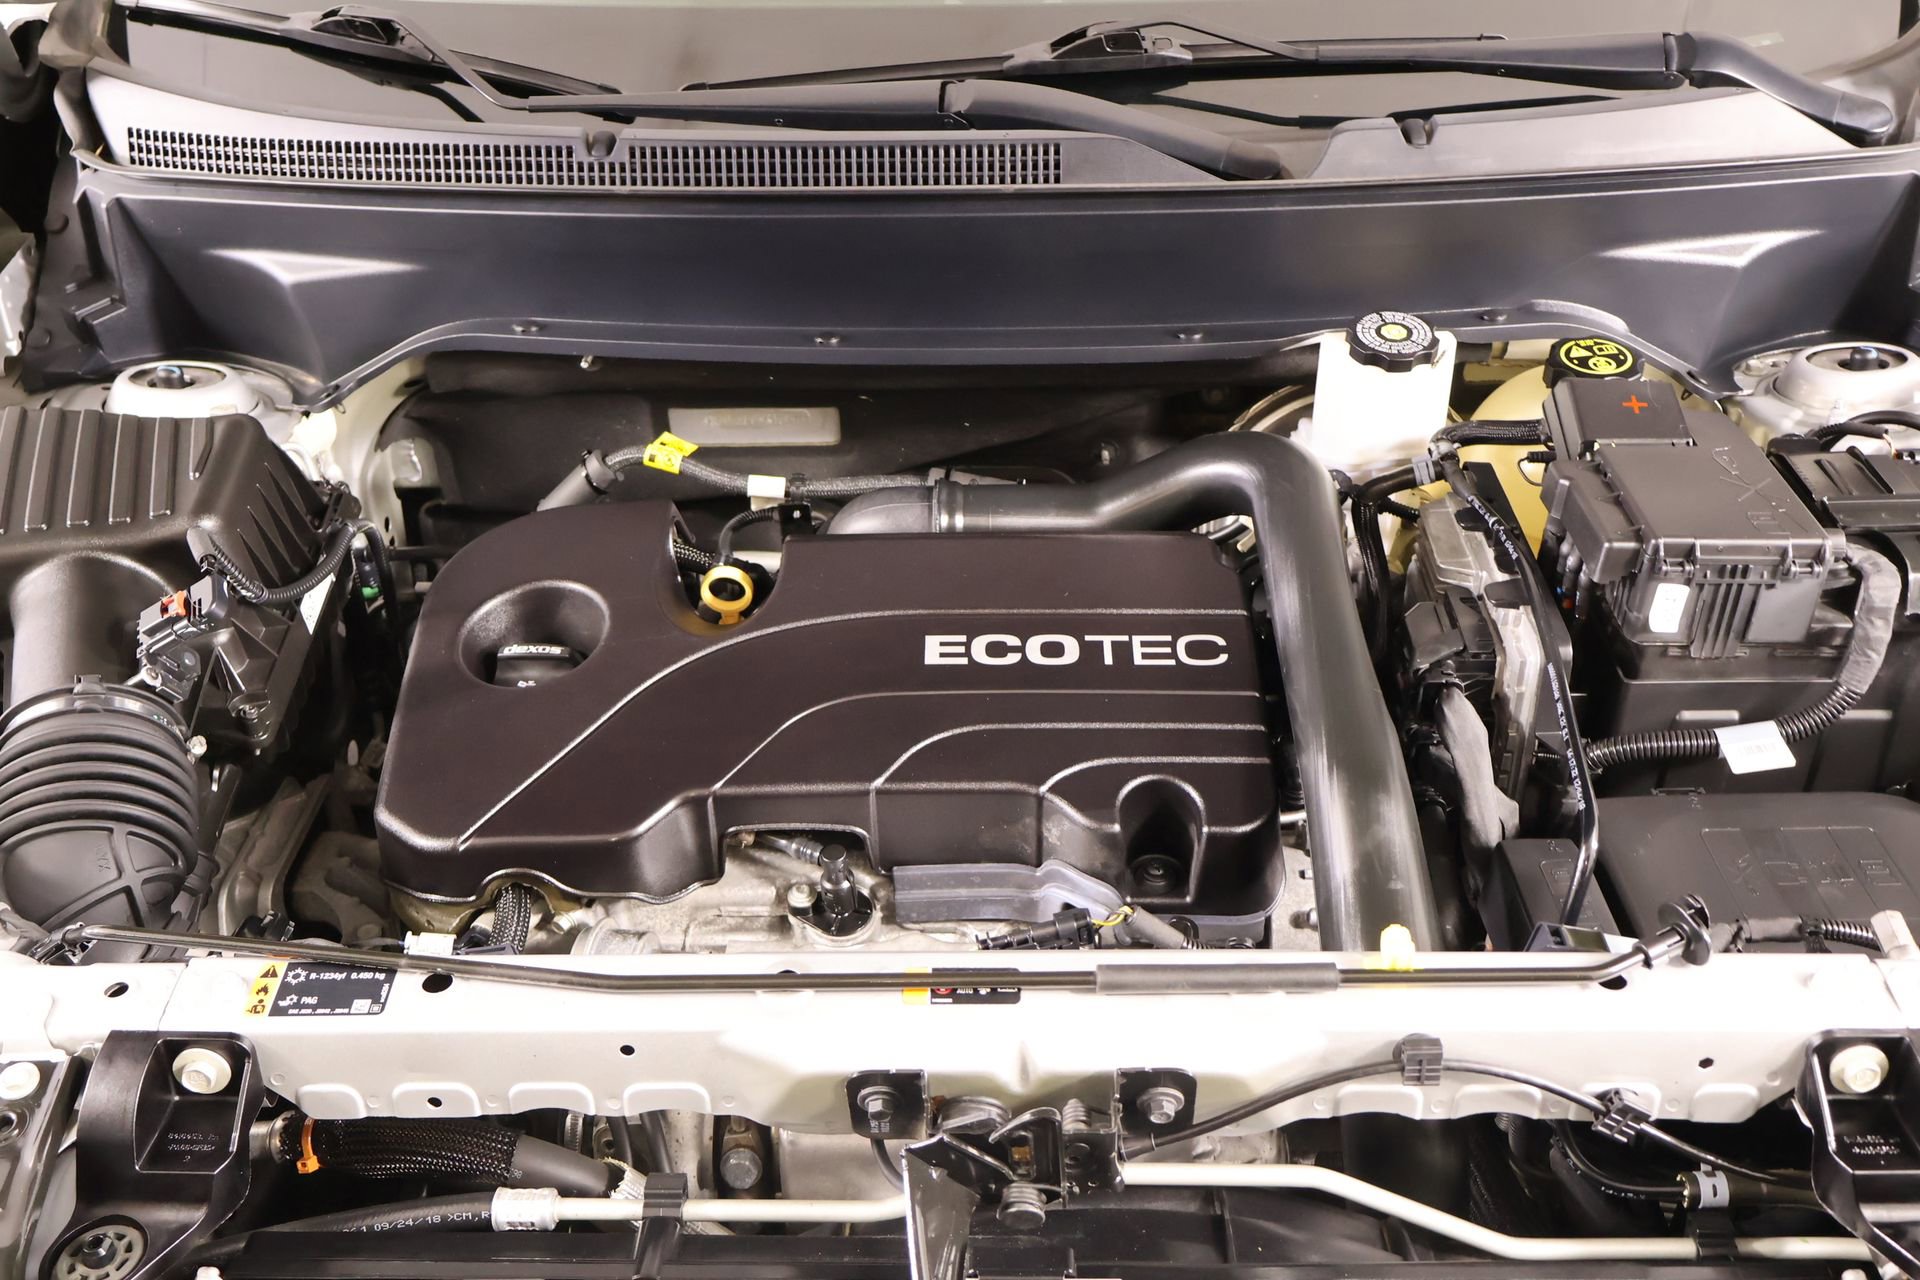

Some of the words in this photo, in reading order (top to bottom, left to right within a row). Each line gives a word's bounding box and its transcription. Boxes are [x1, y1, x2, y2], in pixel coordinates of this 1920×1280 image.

[503, 644, 564, 654] dexos
[924, 633, 1229, 666] ECOTEC
[309, 972, 347, 982] R-1234yf
[374, 972, 386, 981] kg
[300, 996, 318, 1004] PAG
[374, 1214, 441, 1232] 09/24/18
